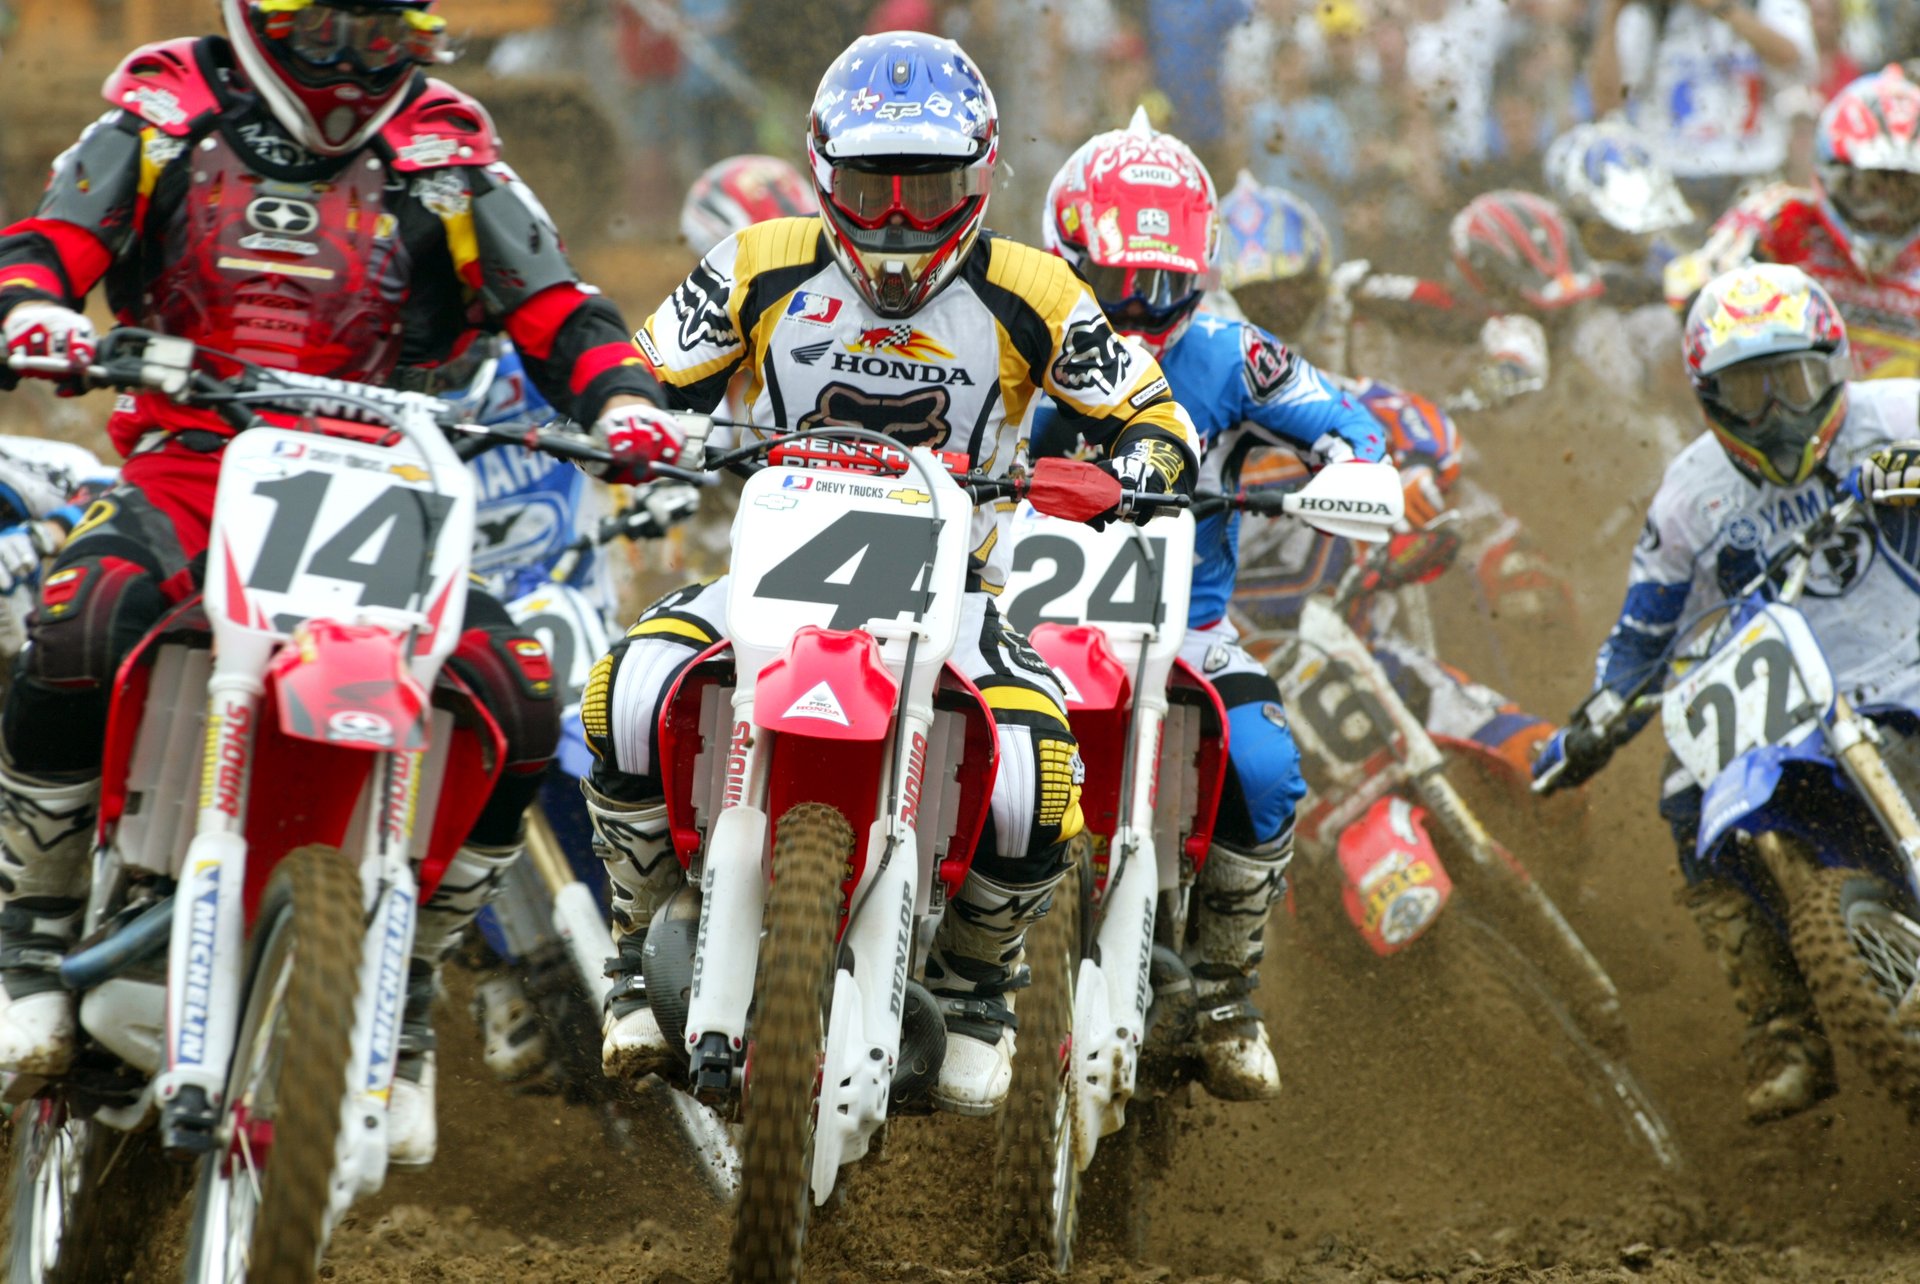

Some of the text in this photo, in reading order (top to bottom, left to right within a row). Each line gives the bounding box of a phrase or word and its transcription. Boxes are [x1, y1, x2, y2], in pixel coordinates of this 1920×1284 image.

[1131, 168, 1172, 181] SHOEI
[1126, 250, 1198, 272] HONDA
[831, 352, 976, 386] HONDA
[247, 470, 457, 611] 14
[815, 480, 884, 499] CHEVY TRUCKS
[1299, 497, 1392, 515] HONDA
[753, 510, 946, 645] 4
[1007, 534, 1166, 637] 24
[217, 700, 251, 817] SHOWA
[796, 705, 840, 716] HONDA
[1686, 638, 1805, 770] 22
[723, 721, 751, 808] SHOW
[181, 900, 216, 1063] MICHELIN
[373, 892, 411, 1057] MICHELIN
[693, 867, 716, 998] DUNLOP
[890, 880, 913, 1022] DUNLOP
[1136, 897, 1153, 1020] DUNLOP
